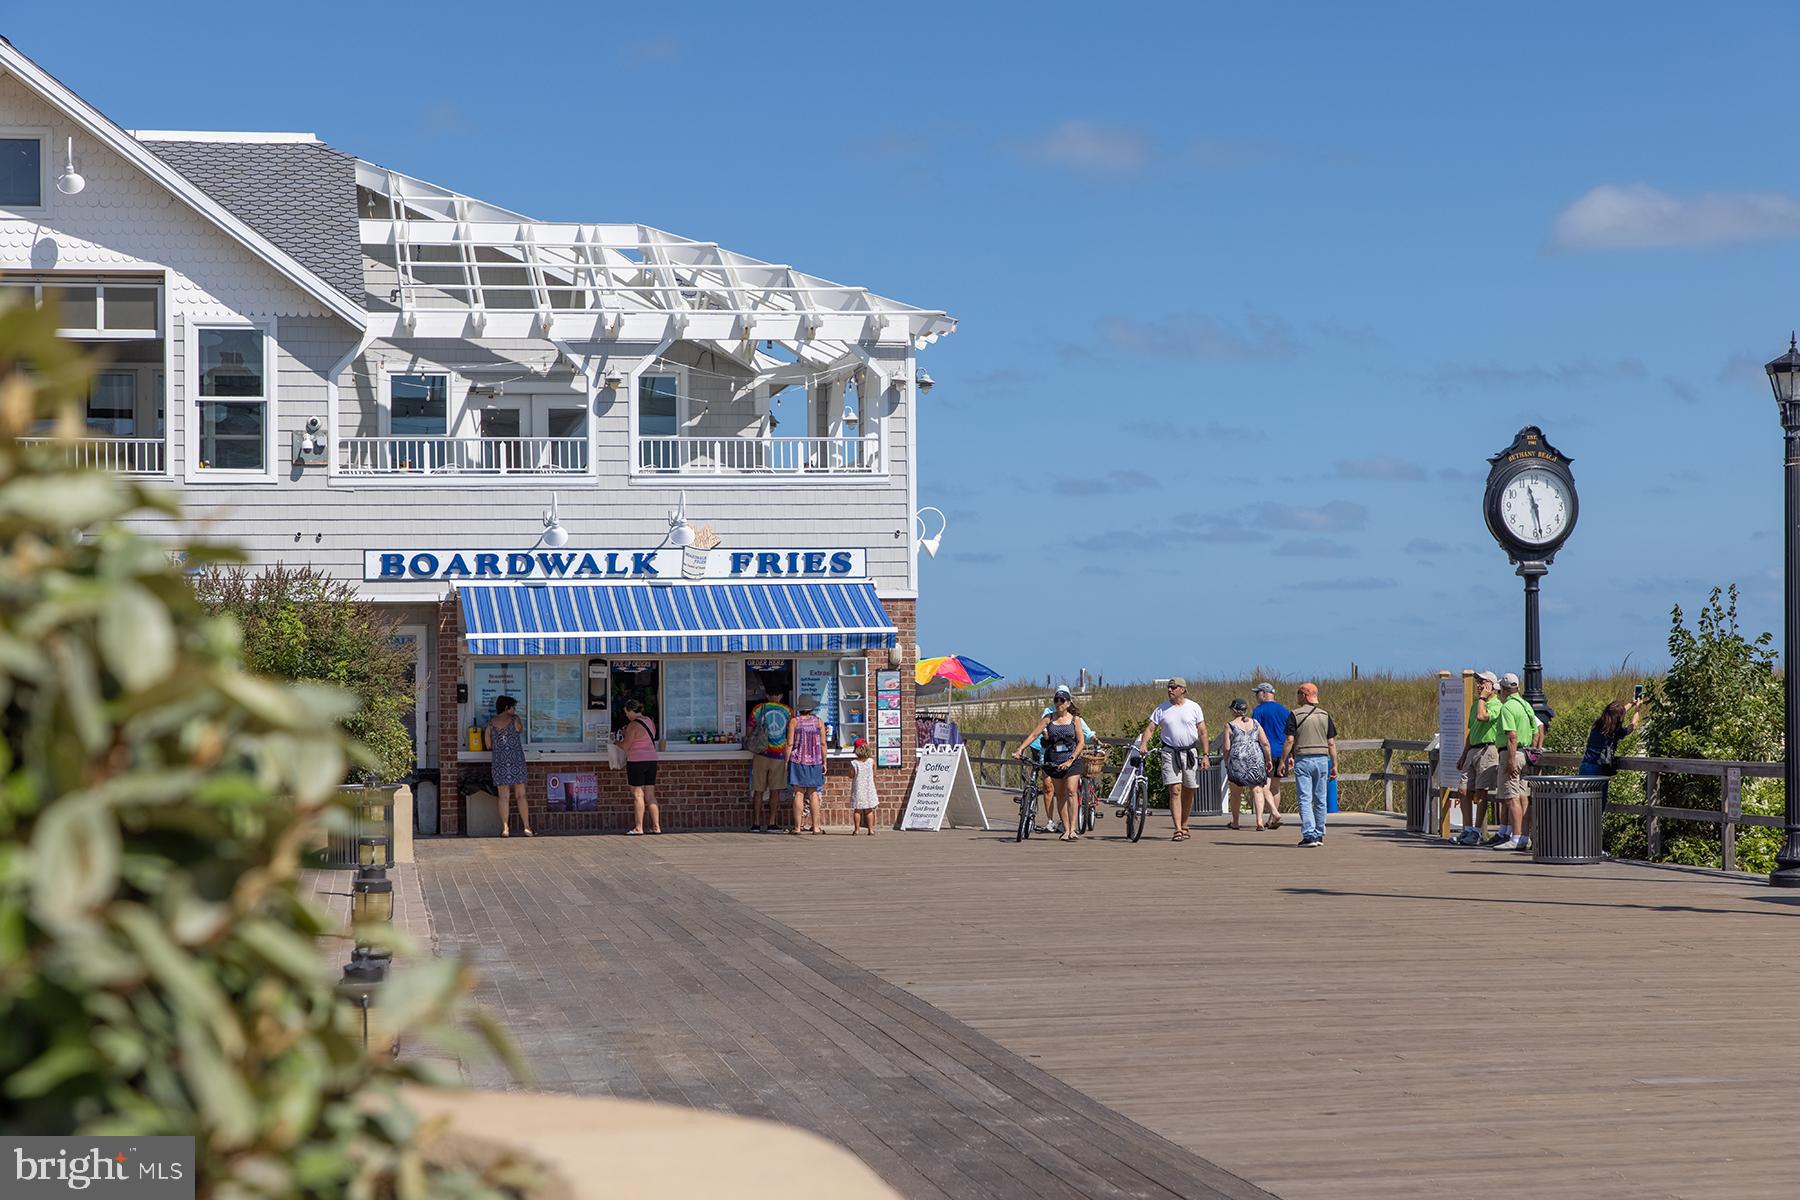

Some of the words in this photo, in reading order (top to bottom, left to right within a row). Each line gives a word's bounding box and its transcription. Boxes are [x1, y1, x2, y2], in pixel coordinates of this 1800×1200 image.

[1508, 451, 1536, 462] BETHANY
[1537, 451, 1558, 462] BEACH
[1519, 479, 1525, 489] 11
[1530, 475, 1539, 485] 12
[1545, 479, 1549, 489] 1
[1509, 489, 1517, 499] 10
[1554, 489, 1560, 499] 2
[1506, 501, 1512, 512] 9
[1558, 502, 1563, 512] 3
[1510, 514, 1516, 525] 8
[1554, 514, 1561, 524] 4
[1519, 525, 1525, 536] 7
[1545, 524, 1552, 535] 5
[379, 552, 660, 577] BOARDWALK
[729, 551, 853, 576] FRIES
[925, 763, 951, 772] Coffee
